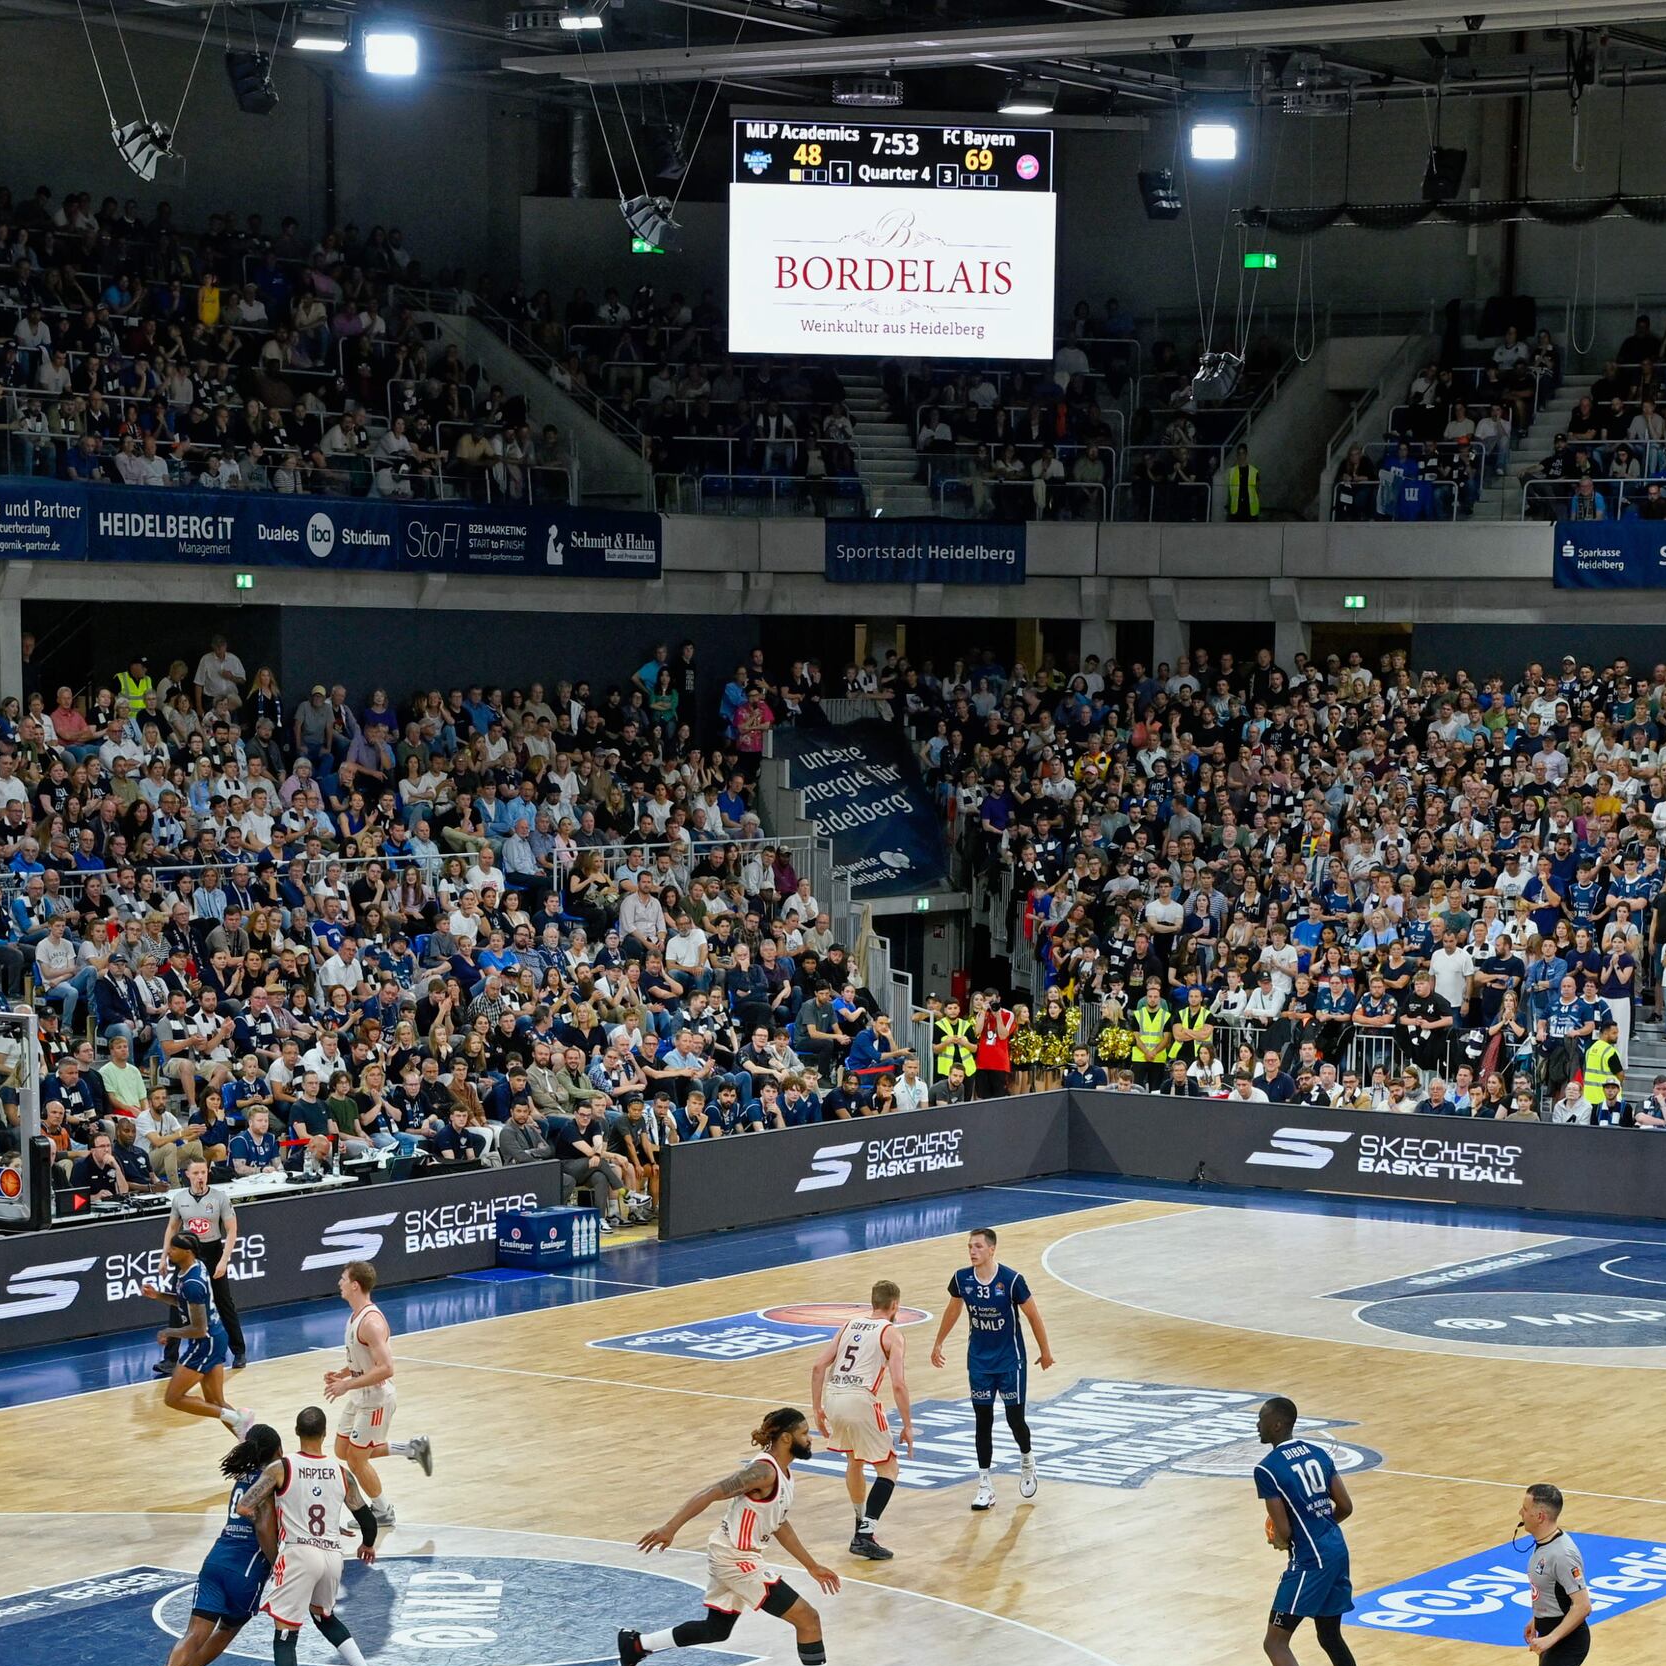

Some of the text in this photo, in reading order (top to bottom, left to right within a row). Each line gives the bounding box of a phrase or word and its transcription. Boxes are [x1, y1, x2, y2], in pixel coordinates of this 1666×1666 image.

[746, 124, 860, 142] MLP Academics
[943, 130, 1015, 149] FC Bayern
[870, 132, 919, 156] 7:53
[793, 144, 822, 166] 48
[965, 149, 993, 171] 69
[836, 167, 845, 181] 1
[858, 164, 931, 183] Quarter 4
[943, 171, 953, 183] 3
[774, 256, 1013, 295] BORDELAIS
[801, 319, 985, 340] Weinkultur aus Heidelberg
[4, 501, 31, 518] und
[34, 500, 82, 520] Partner
[99, 512, 214, 540] HEIDELBERG
[258, 523, 391, 547] Duales iba Studium
[468, 523, 527, 537] B2B MARKETING
[178, 541, 231, 557] Management
[570, 530, 655, 551] Schmitt & Hahn
[836, 543, 1016, 566] Sportstadt Heidelberg
[1578, 547, 1621, 560] Sparkasse
[1577, 559, 1624, 571] Heidelberg
[798, 744, 867, 771] unsere
[815, 788, 913, 836] eidelberg
[867, 1128, 963, 1162] SKECHERS
[1359, 1134, 1523, 1166] SKECHERS
[865, 1150, 964, 1181] BASKETBALL
[1357, 1157, 1524, 1185] BASKETBALL
[499, 1238, 534, 1252] Ensinger
[540, 1239, 567, 1251] Ensinger
[976, 1285, 991, 1299] 33
[980, 1317, 1006, 1331] MLP
[1511, 1310, 1666, 1327] MLP
[685, 1333, 830, 1357] BBL
[839, 1345, 860, 1373] 5
[1281, 1444, 1311, 1462] DIBBA
[298, 1467, 336, 1480] NAPIER
[1291, 1459, 1327, 1498] 10
[308, 1503, 326, 1537] 8
